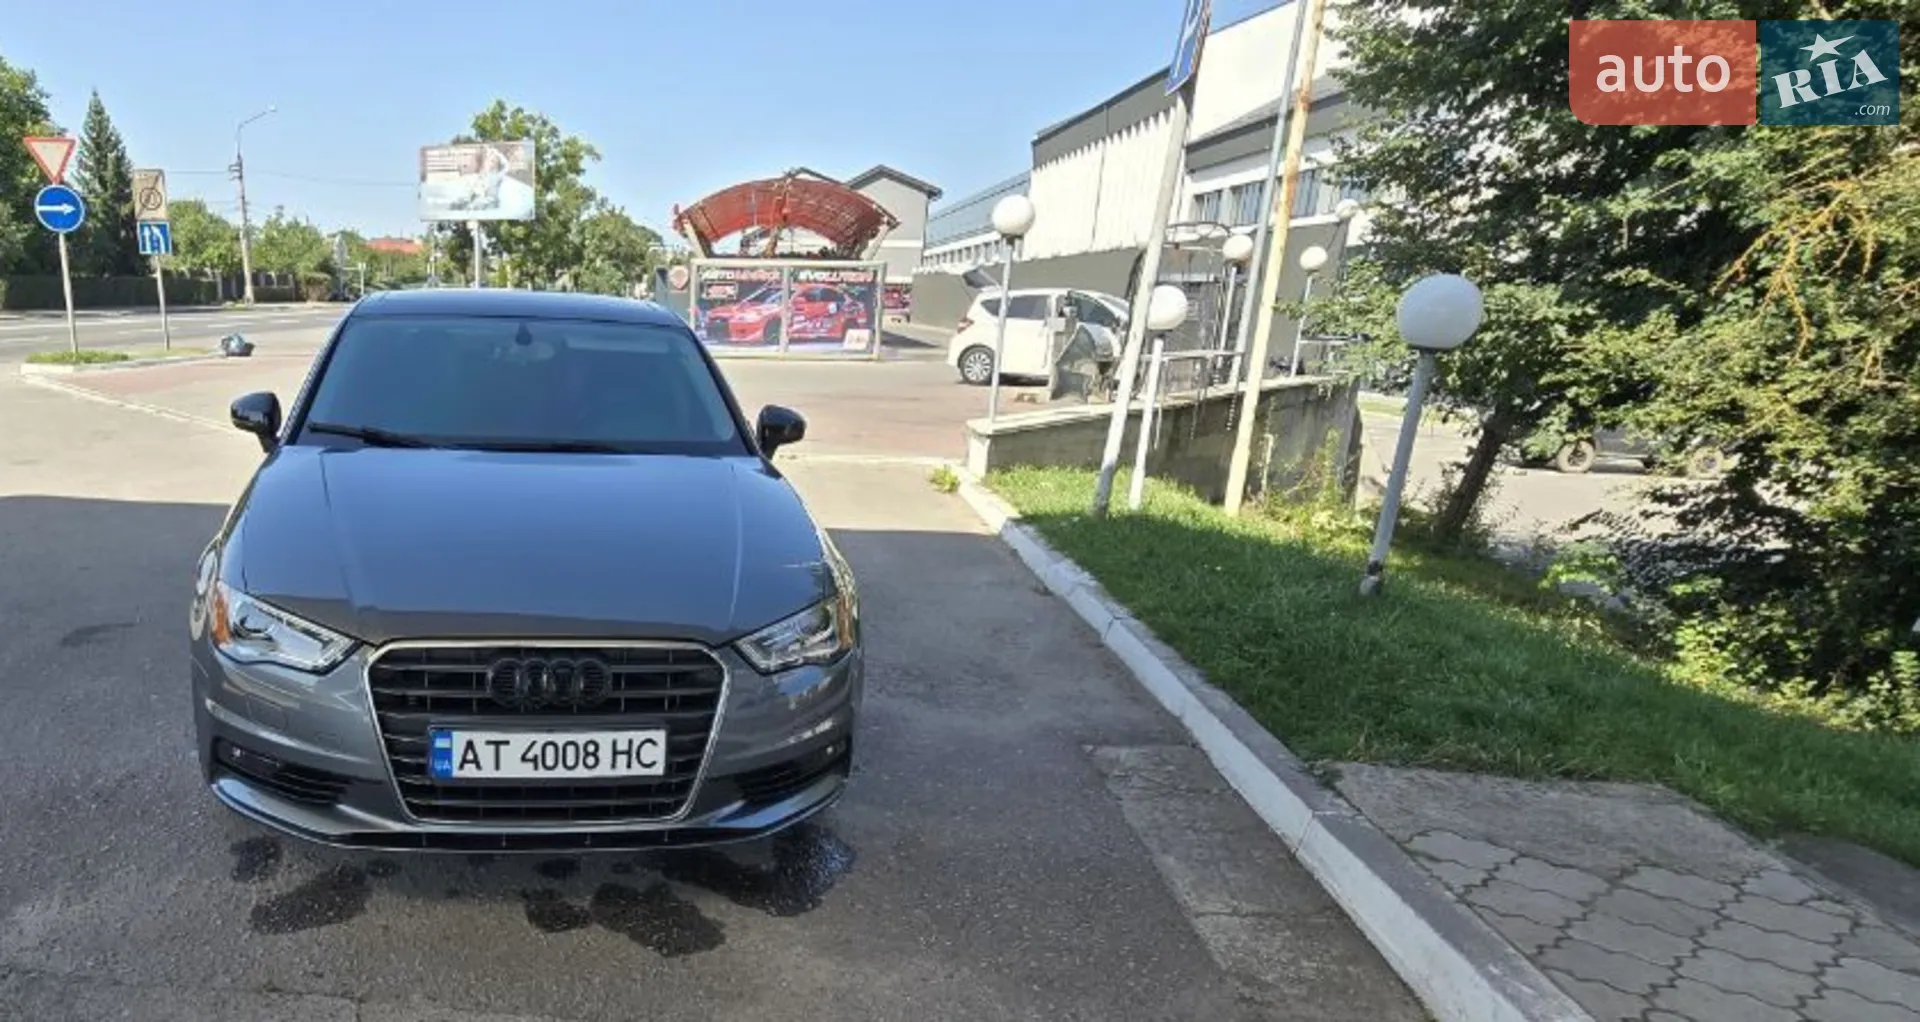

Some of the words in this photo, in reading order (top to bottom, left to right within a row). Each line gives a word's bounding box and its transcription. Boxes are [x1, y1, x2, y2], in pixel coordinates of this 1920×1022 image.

[458, 739, 511, 771] AT
[520, 739, 600, 771] 4008
[610, 738, 658, 770] HC
